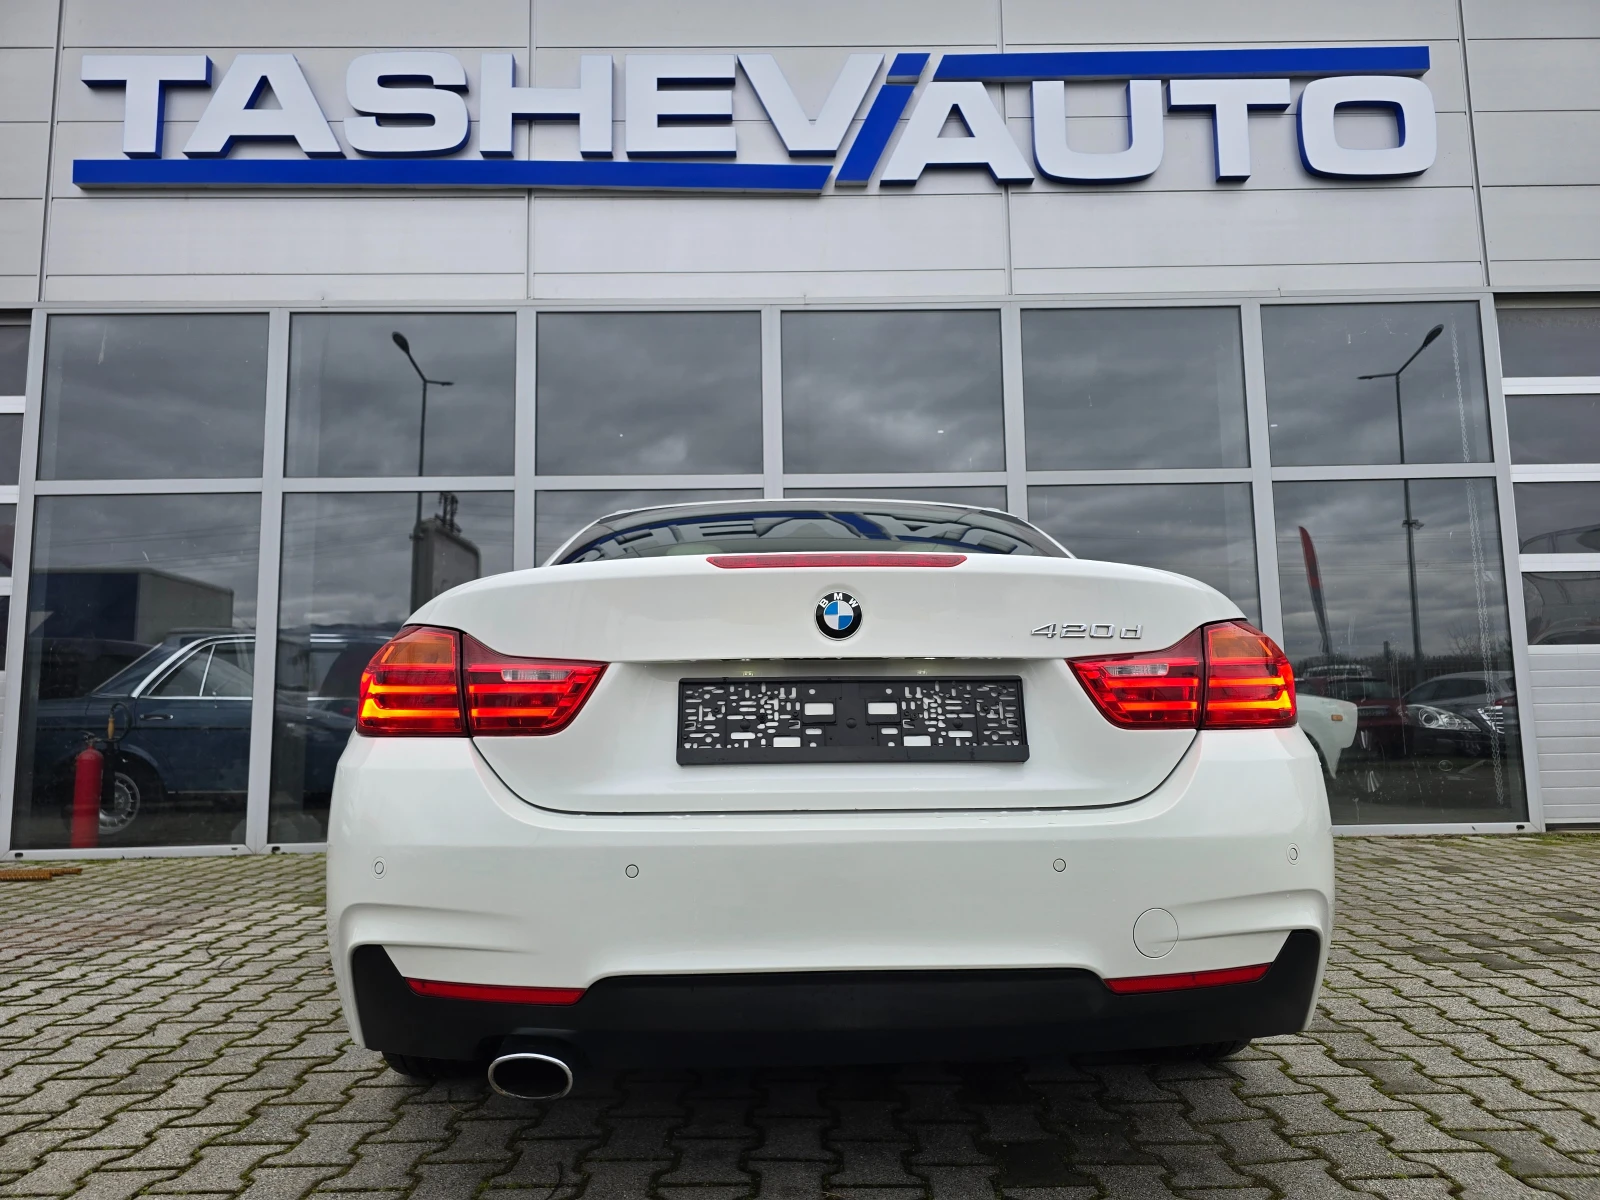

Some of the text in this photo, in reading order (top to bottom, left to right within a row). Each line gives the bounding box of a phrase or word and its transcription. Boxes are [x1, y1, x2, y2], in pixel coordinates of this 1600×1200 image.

[81, 51, 1437, 187] TASHEV AUTO
[819, 592, 859, 608] BMW
